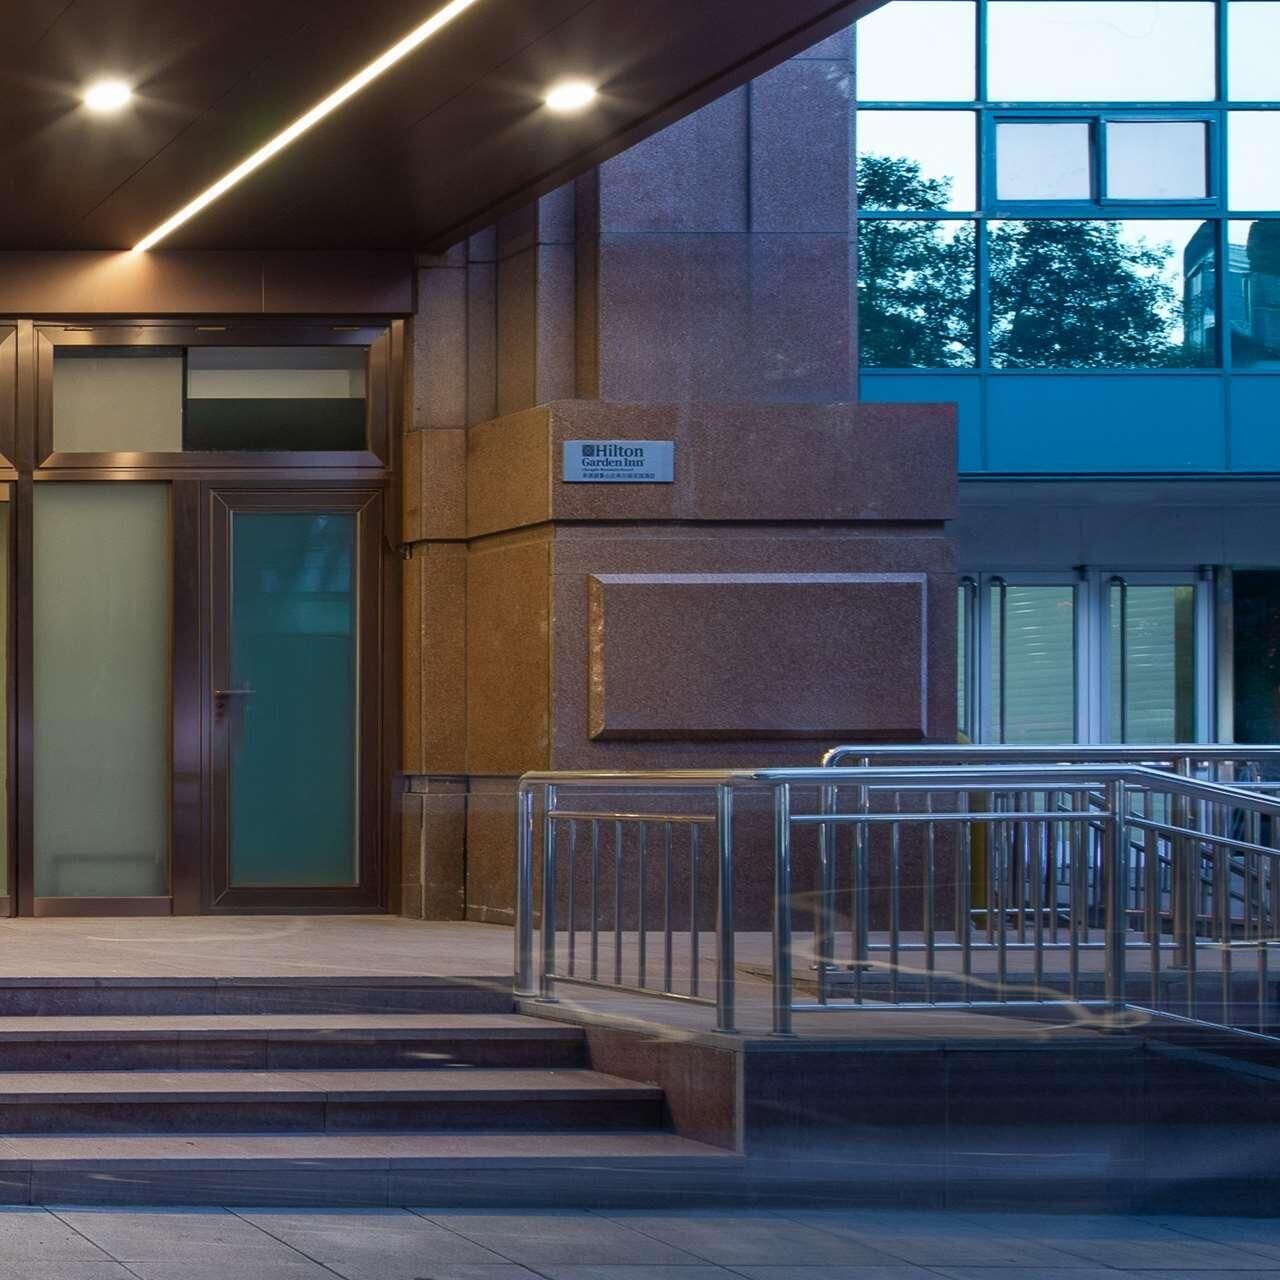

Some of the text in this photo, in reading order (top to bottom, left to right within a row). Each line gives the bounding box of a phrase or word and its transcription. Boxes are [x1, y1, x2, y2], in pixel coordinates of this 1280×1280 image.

[596, 444, 644, 457] Hilton
[582, 458, 644, 467] Garden Inn
